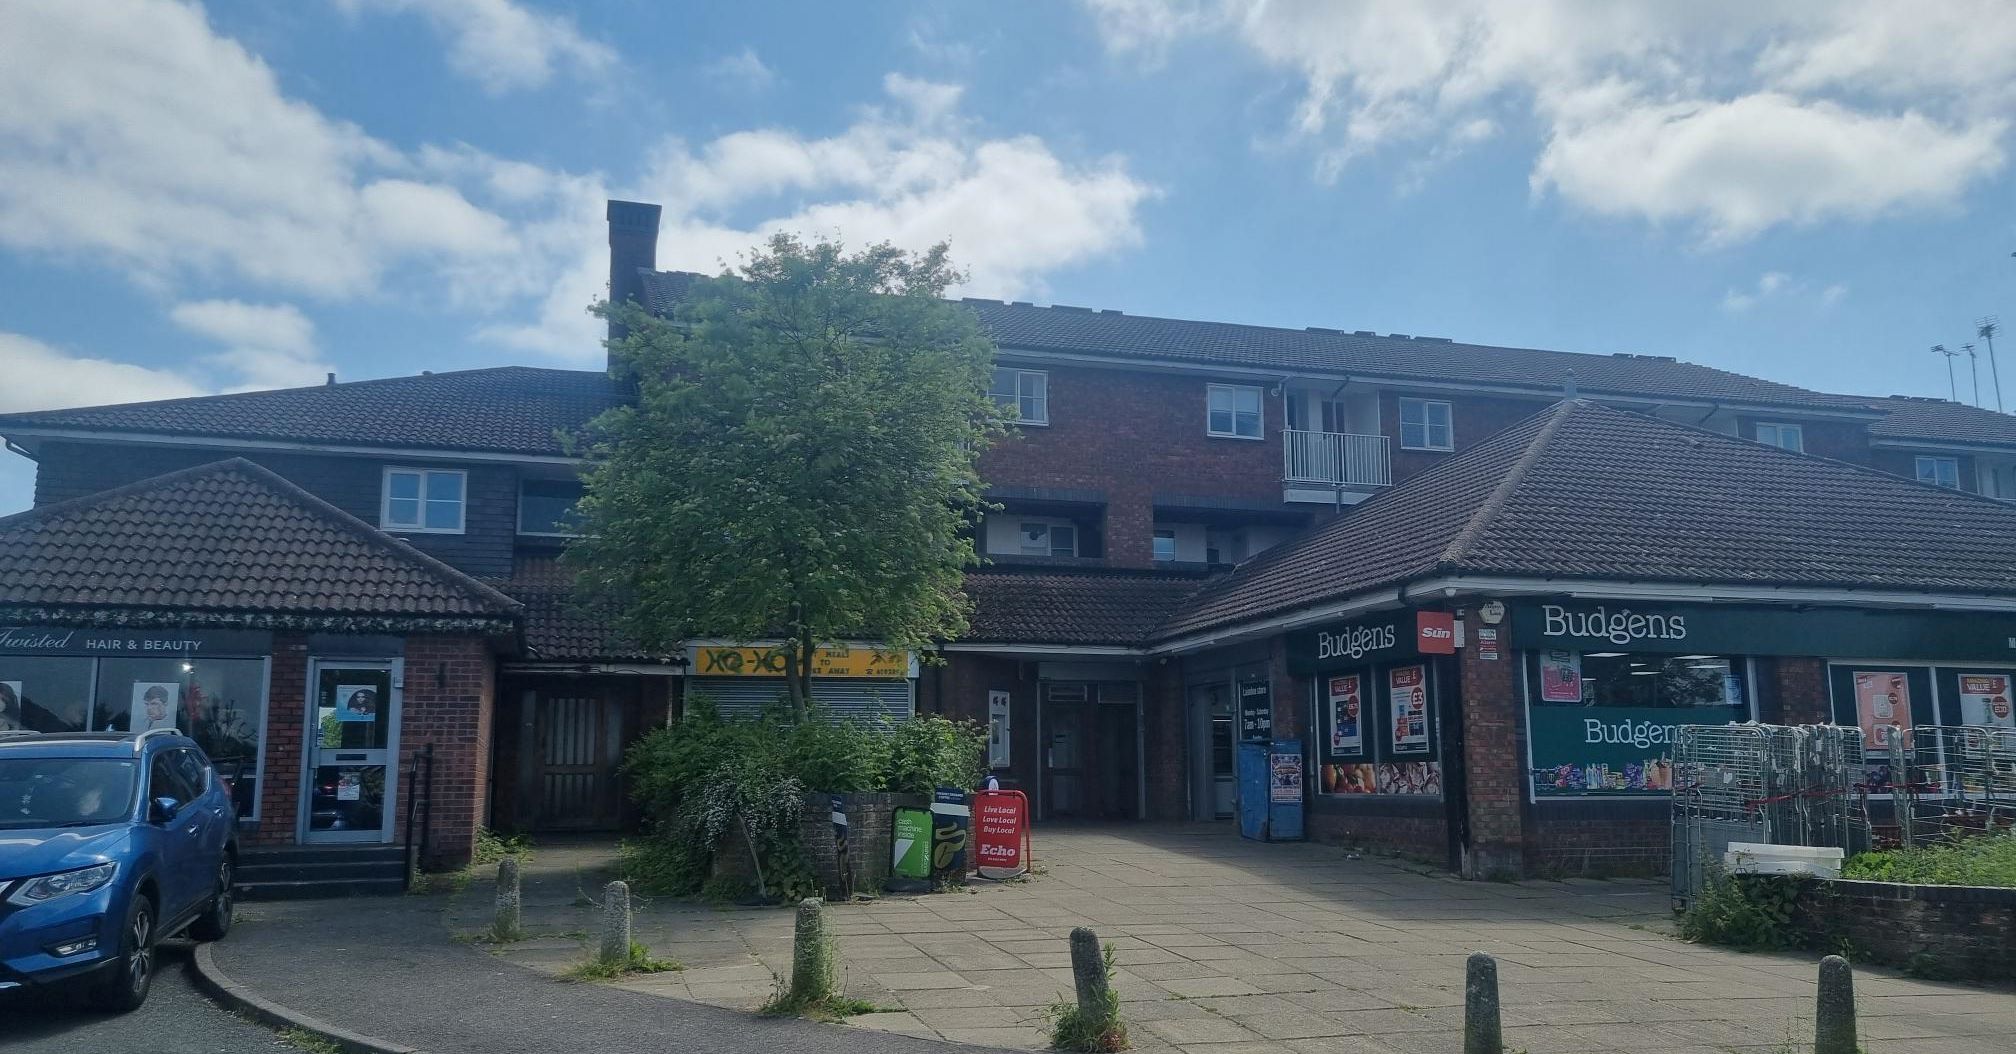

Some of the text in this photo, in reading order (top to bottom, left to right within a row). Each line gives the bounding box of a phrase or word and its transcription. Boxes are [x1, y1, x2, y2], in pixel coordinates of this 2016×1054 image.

[1542, 605, 1687, 645] Budgens
[1422, 627, 1451, 639] Sun
[86, 639, 121, 650] HAIR
[127, 639, 138, 650] &
[143, 640, 202, 651] BEAUTY
[1318, 624, 1396, 660] Budgens
[1966, 683, 1991, 691] VALUE
[1412, 692, 1423, 705] £3
[1244, 718, 1255, 731] 7am
[1257, 717, 1271, 731] 10pm
[984, 805, 1016, 814] Live Local
[983, 815, 1017, 825] Love Local
[983, 825, 1015, 834] Buy Local
[980, 843, 1016, 857] Echo
